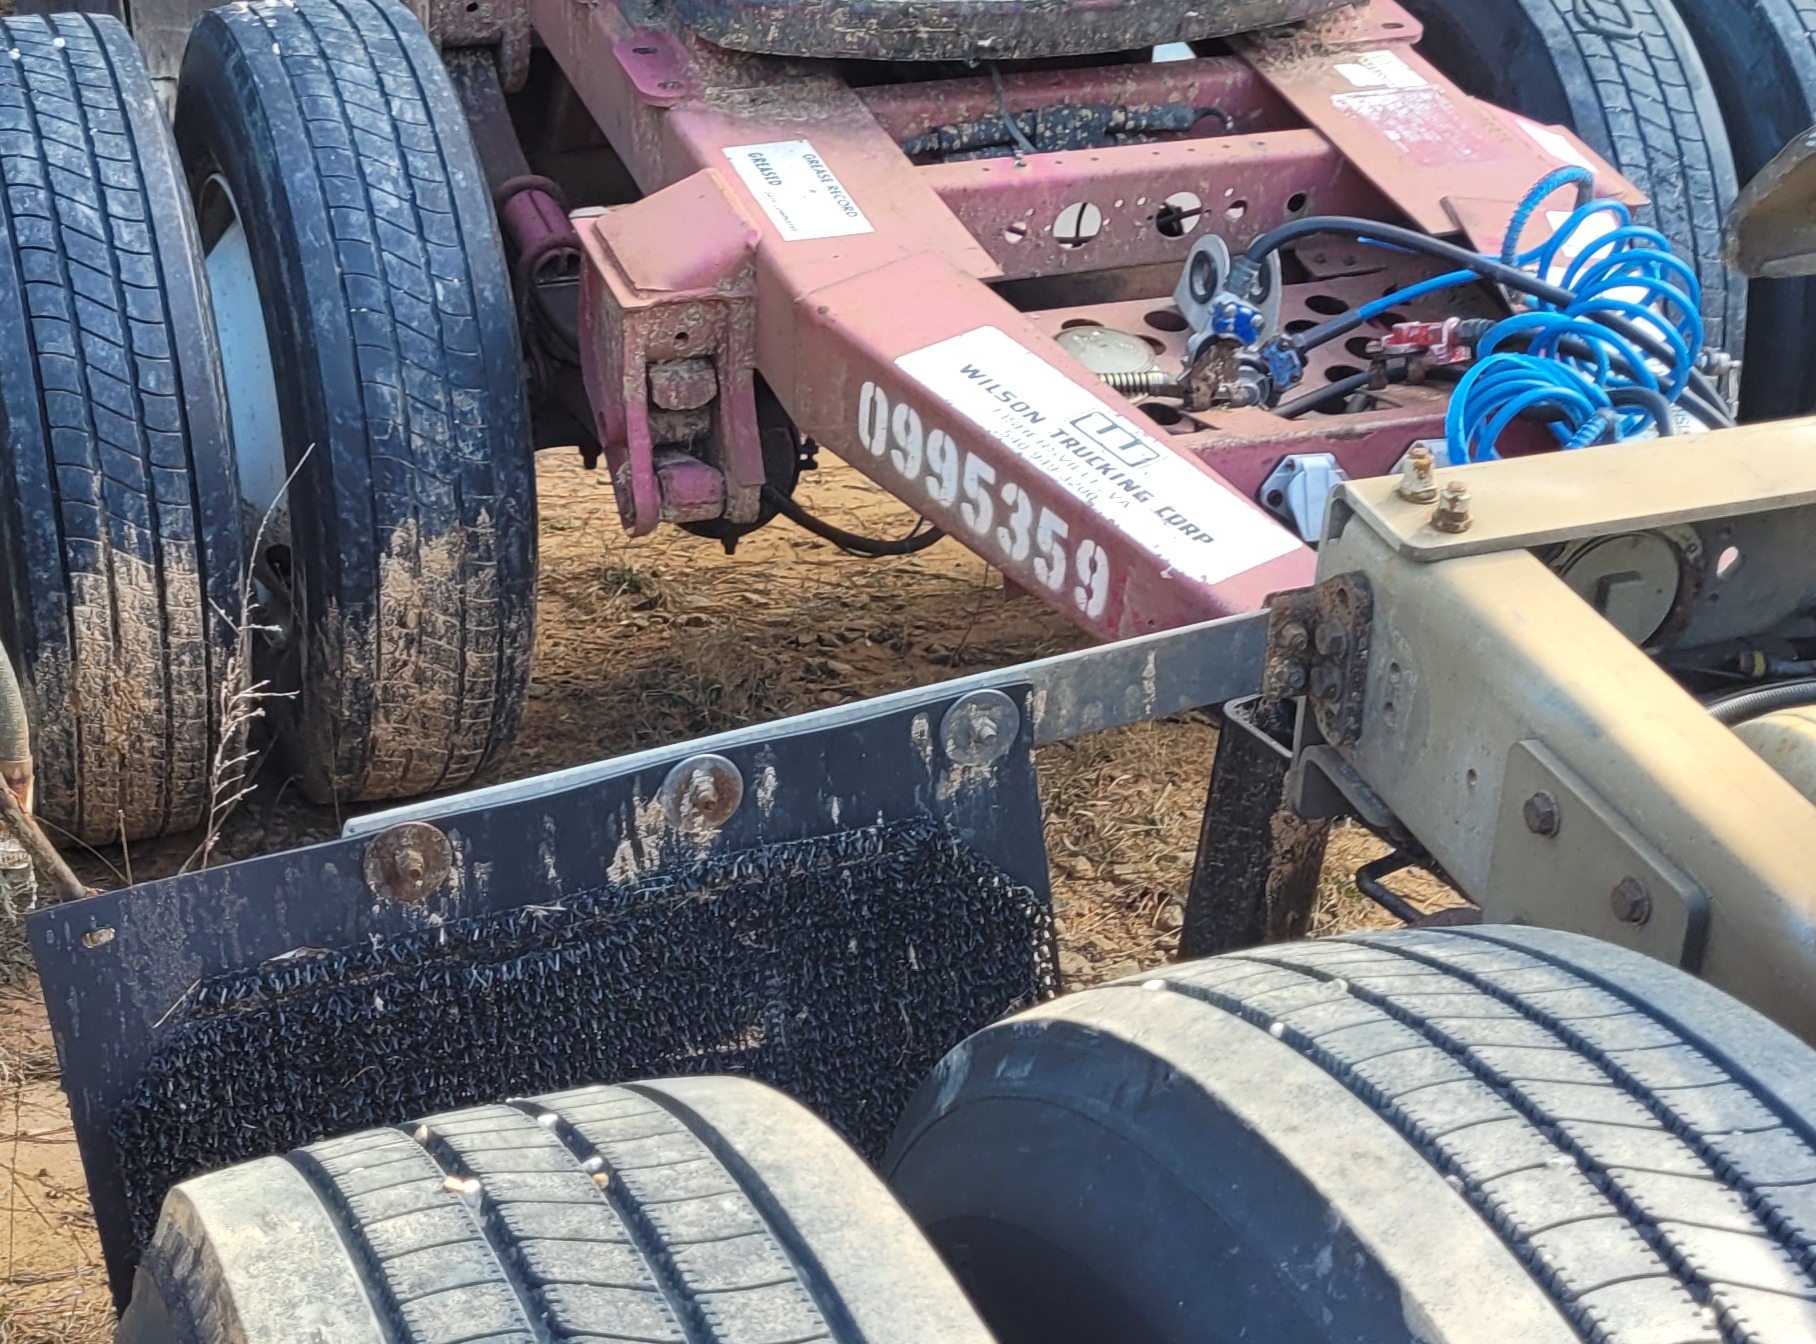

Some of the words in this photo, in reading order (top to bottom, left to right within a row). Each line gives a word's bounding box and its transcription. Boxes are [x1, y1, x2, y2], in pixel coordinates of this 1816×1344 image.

[747, 152, 782, 186] GREASED
[802, 153, 834, 183] GREASE
[827, 185, 858, 218] RECORD
[960, 363, 1046, 424] WILSON
[1050, 428, 1155, 504] TRUCKING
[1155, 506, 1214, 544] CORP
[857, 379, 1112, 621] 0995359
[1108, 492, 1131, 509] VA
